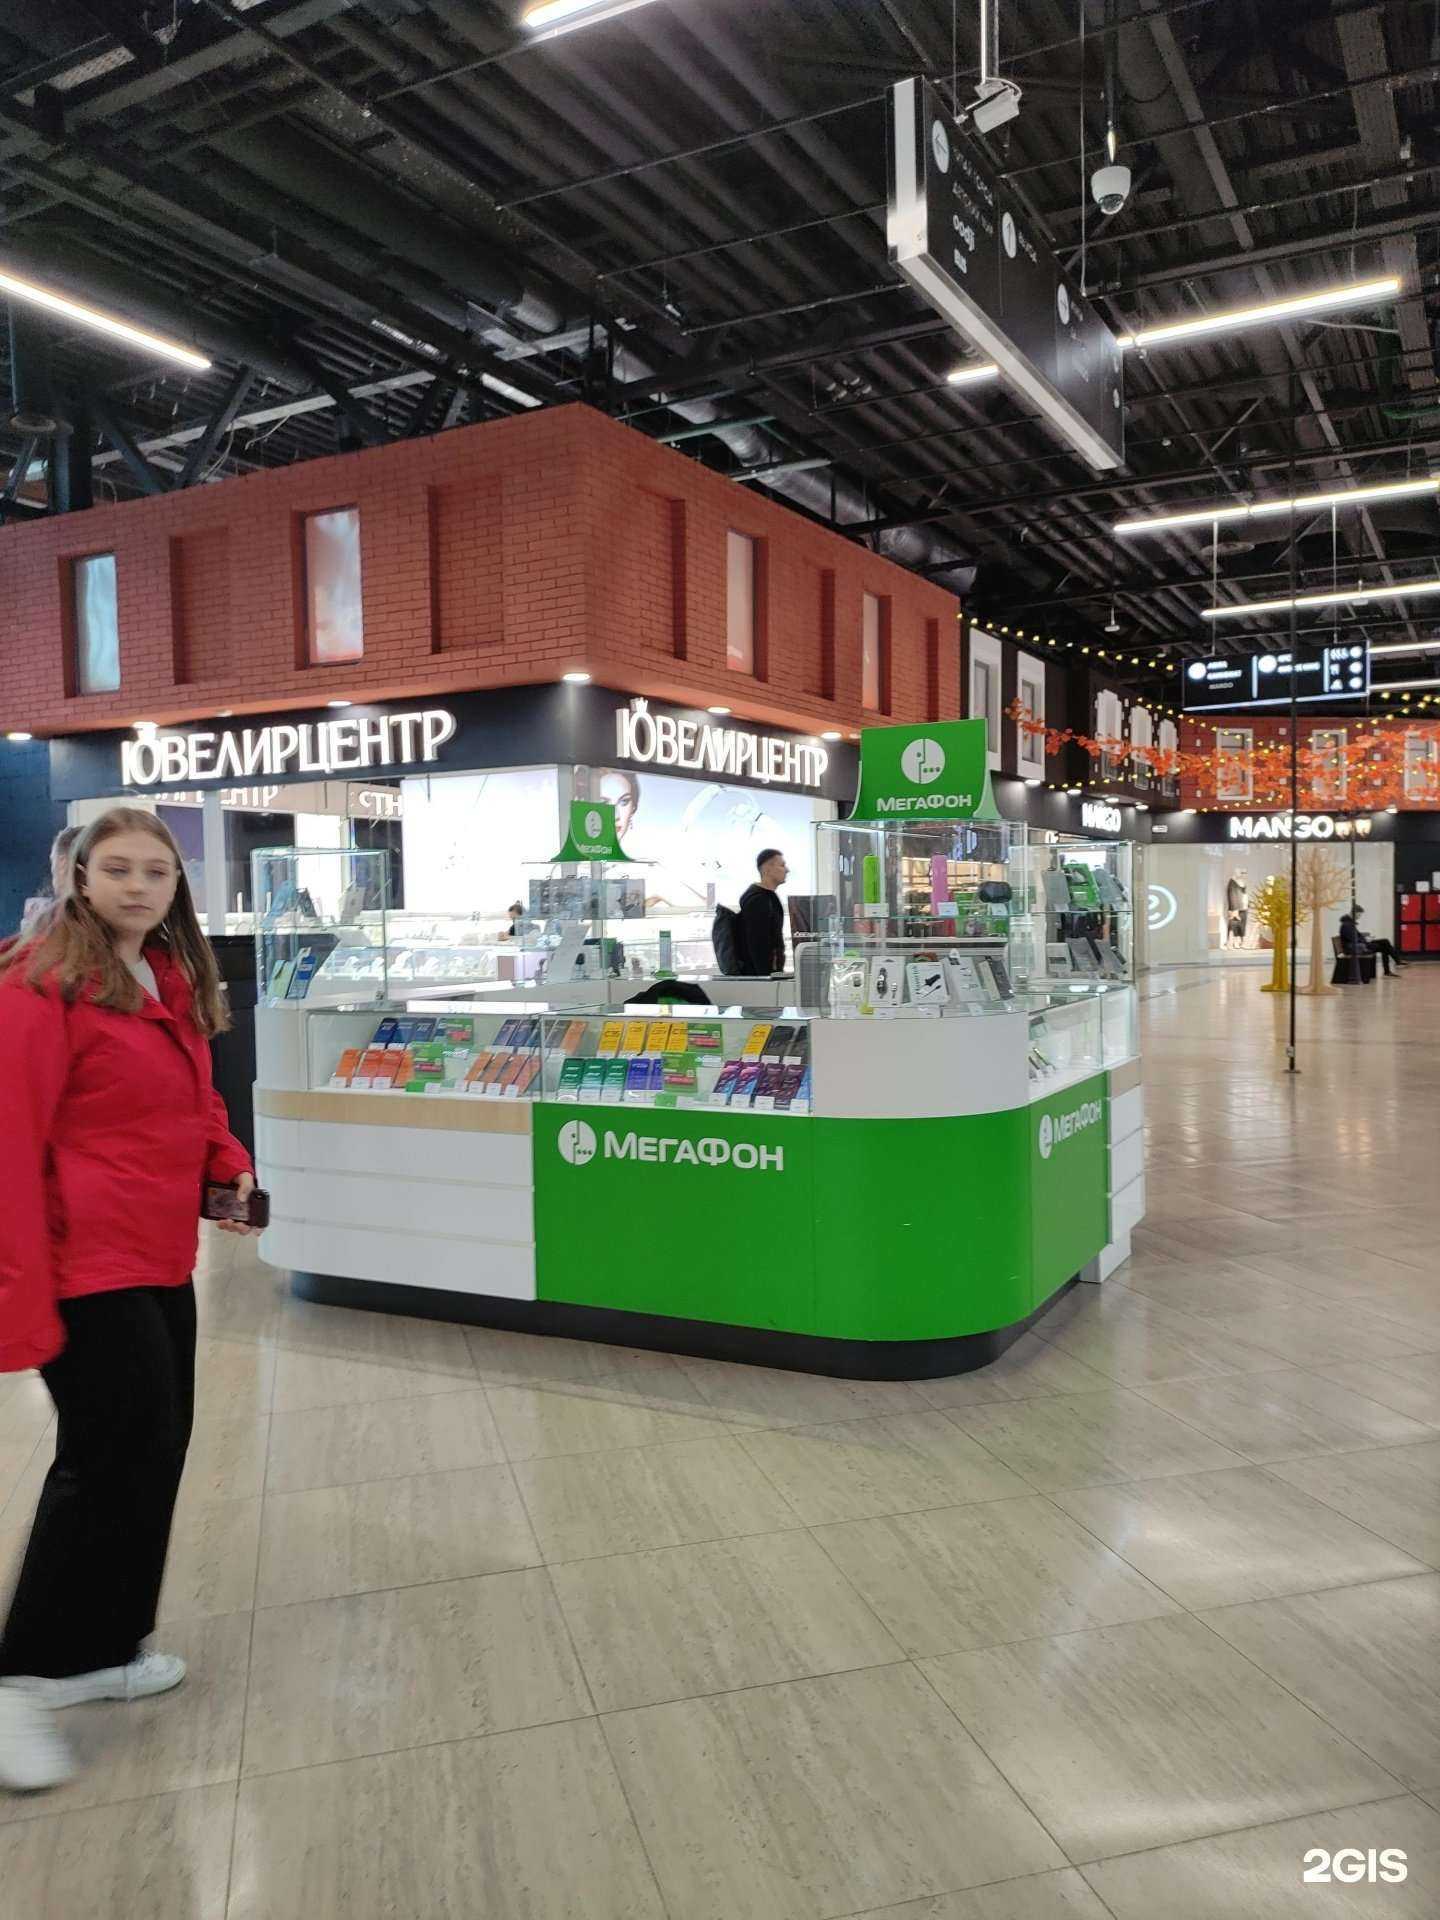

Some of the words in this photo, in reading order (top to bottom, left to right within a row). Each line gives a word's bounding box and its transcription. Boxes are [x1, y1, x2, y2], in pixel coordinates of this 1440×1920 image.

[121, 710, 455, 786] ЮВЕЛИРЦЕНТР
[616, 700, 828, 787] ЮВЕЛИРЦЕНТР
[876, 794, 972, 812] МЕГАФОН
[1053, 1099, 1102, 1145] МЕГАФОН
[603, 1130, 784, 1171] МЕГАФОН
